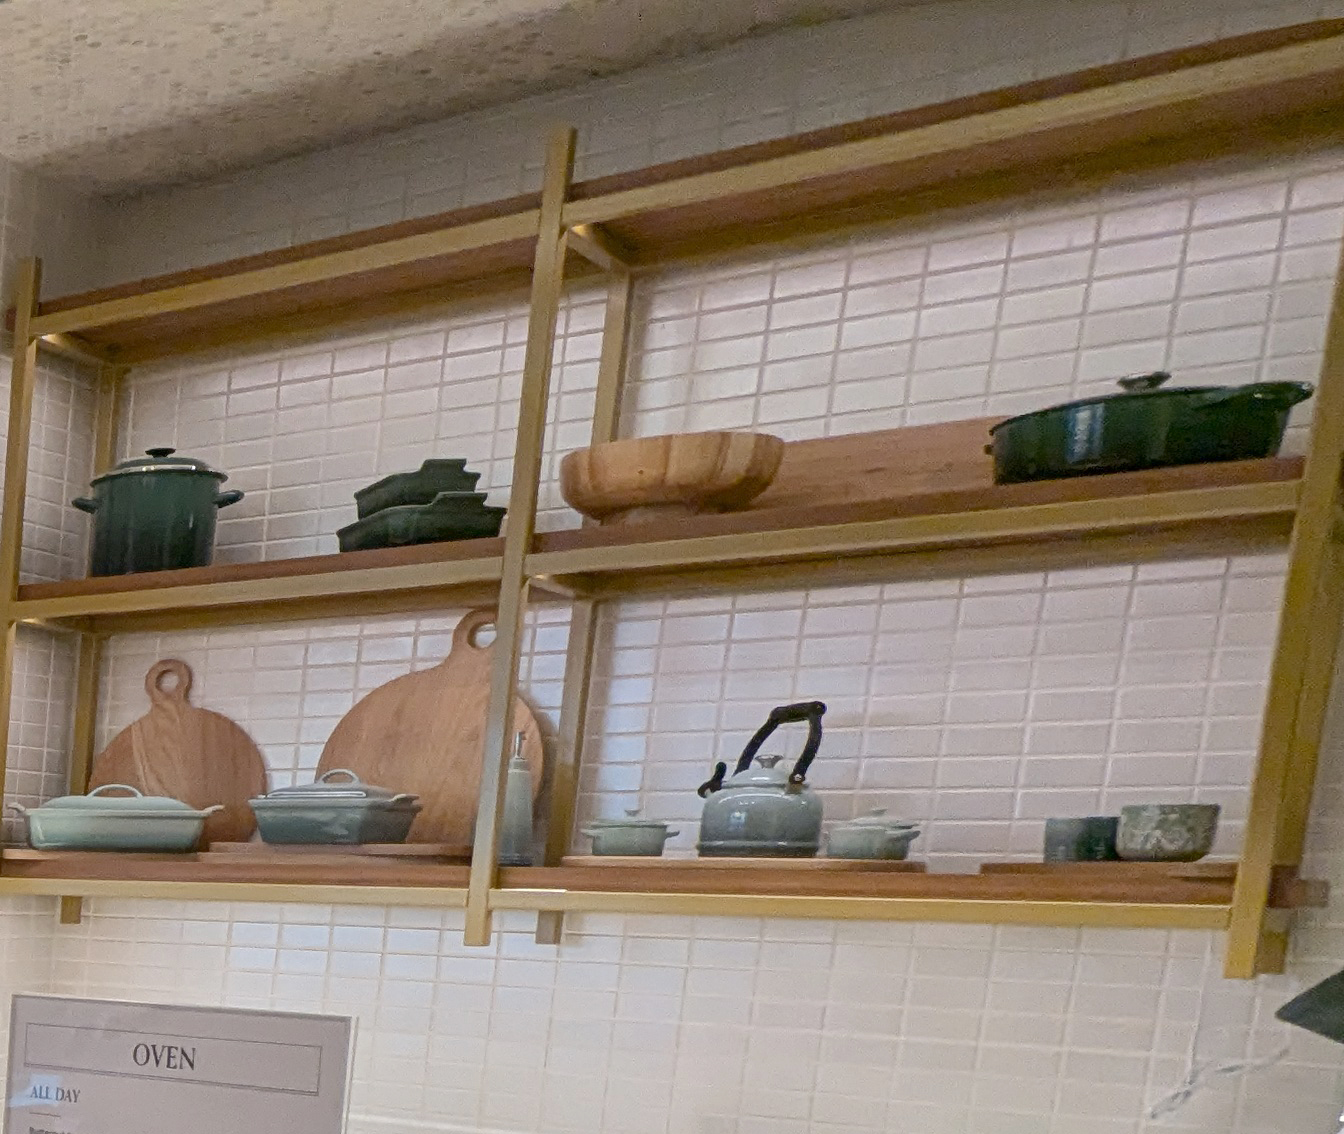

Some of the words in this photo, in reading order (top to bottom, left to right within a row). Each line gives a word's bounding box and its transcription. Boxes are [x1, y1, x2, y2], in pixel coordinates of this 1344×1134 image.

[133, 1043, 196, 1071] OVEN
[30, 1085, 53, 1100] ALL
[55, 1087, 81, 1103] DAY
